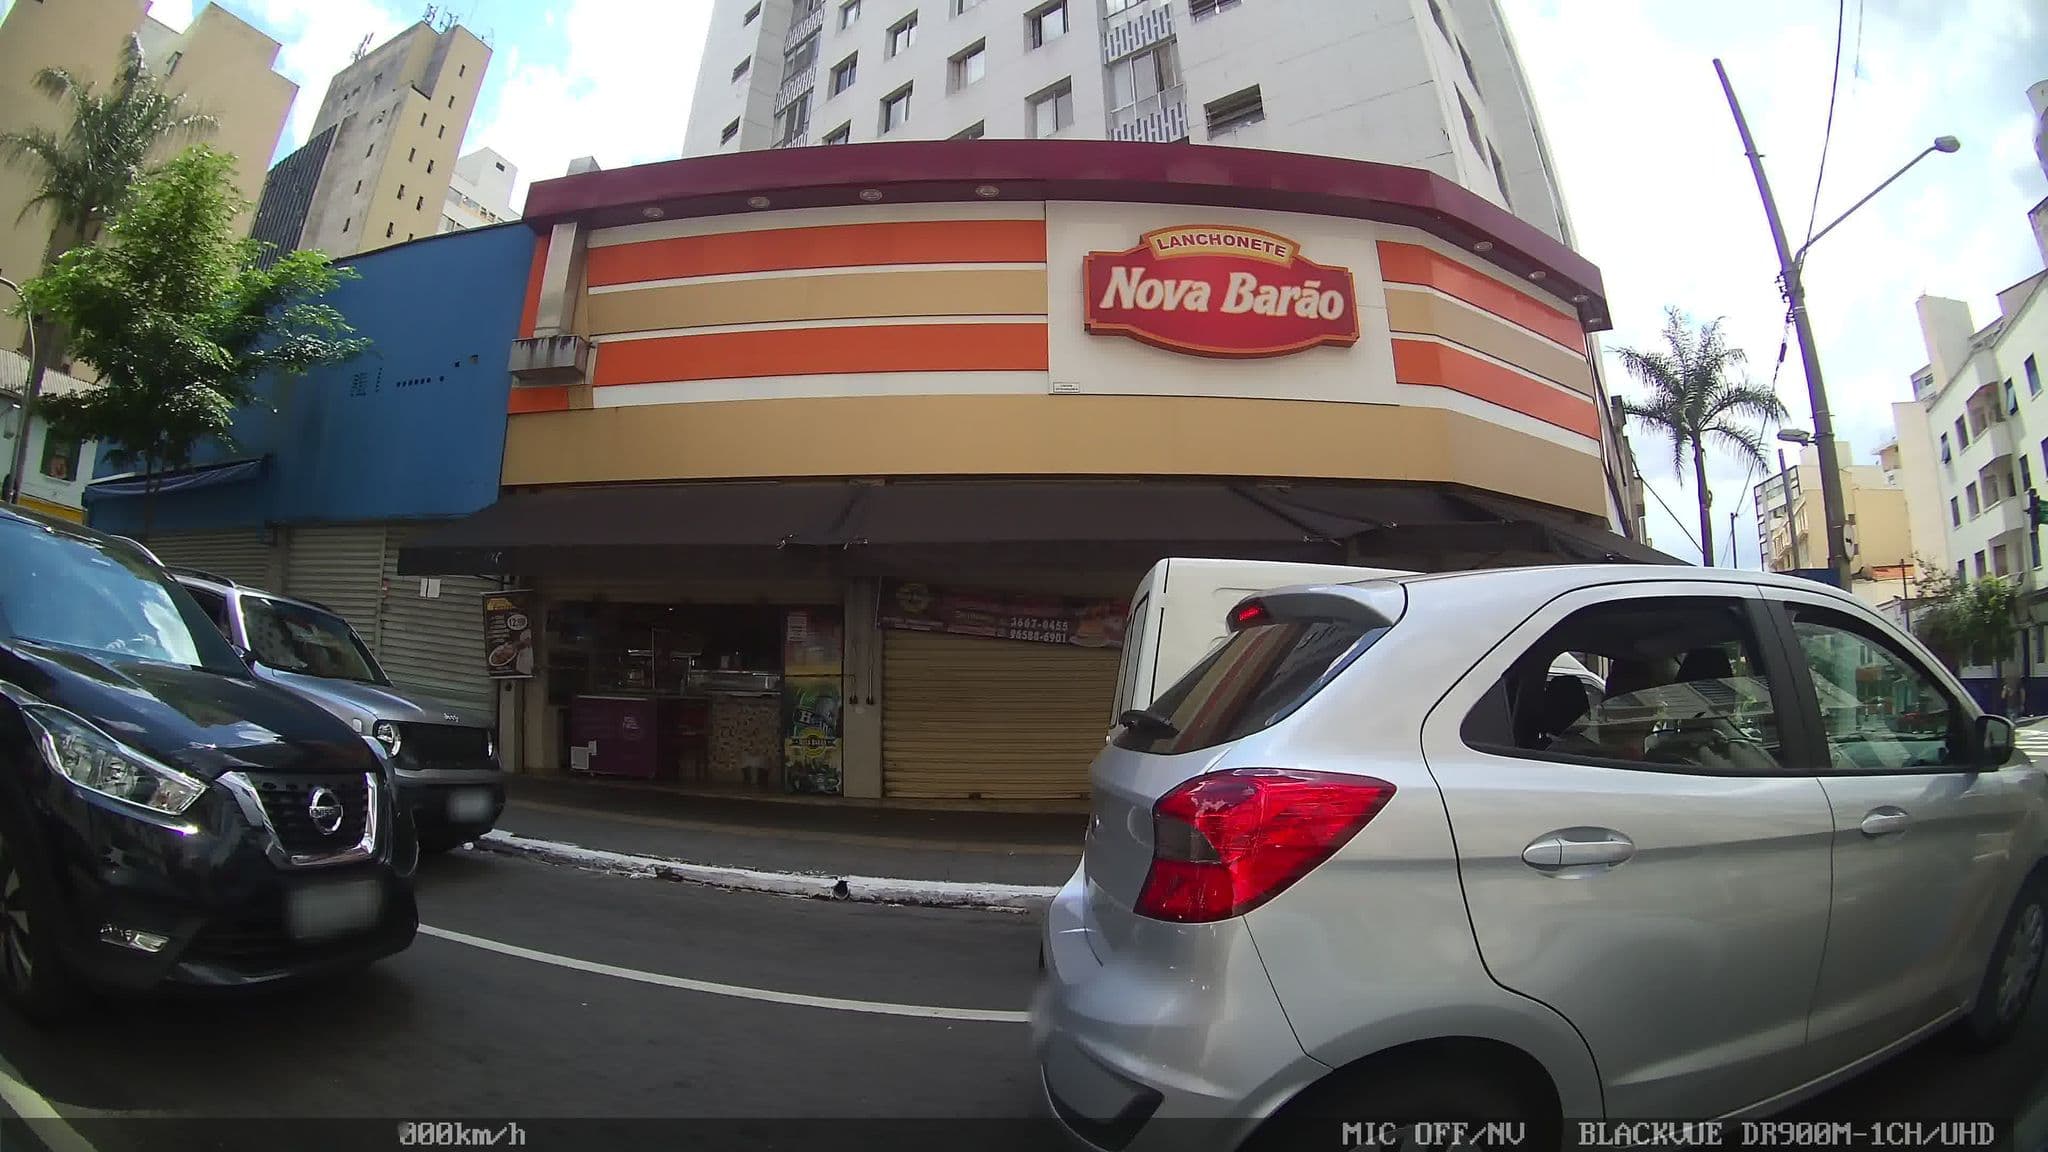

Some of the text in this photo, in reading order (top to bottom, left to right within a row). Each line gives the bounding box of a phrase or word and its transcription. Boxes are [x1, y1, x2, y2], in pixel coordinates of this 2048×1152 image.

[1156, 233, 1287, 258] LANCHONETE
[1099, 266, 1345, 320] Nova Barão
